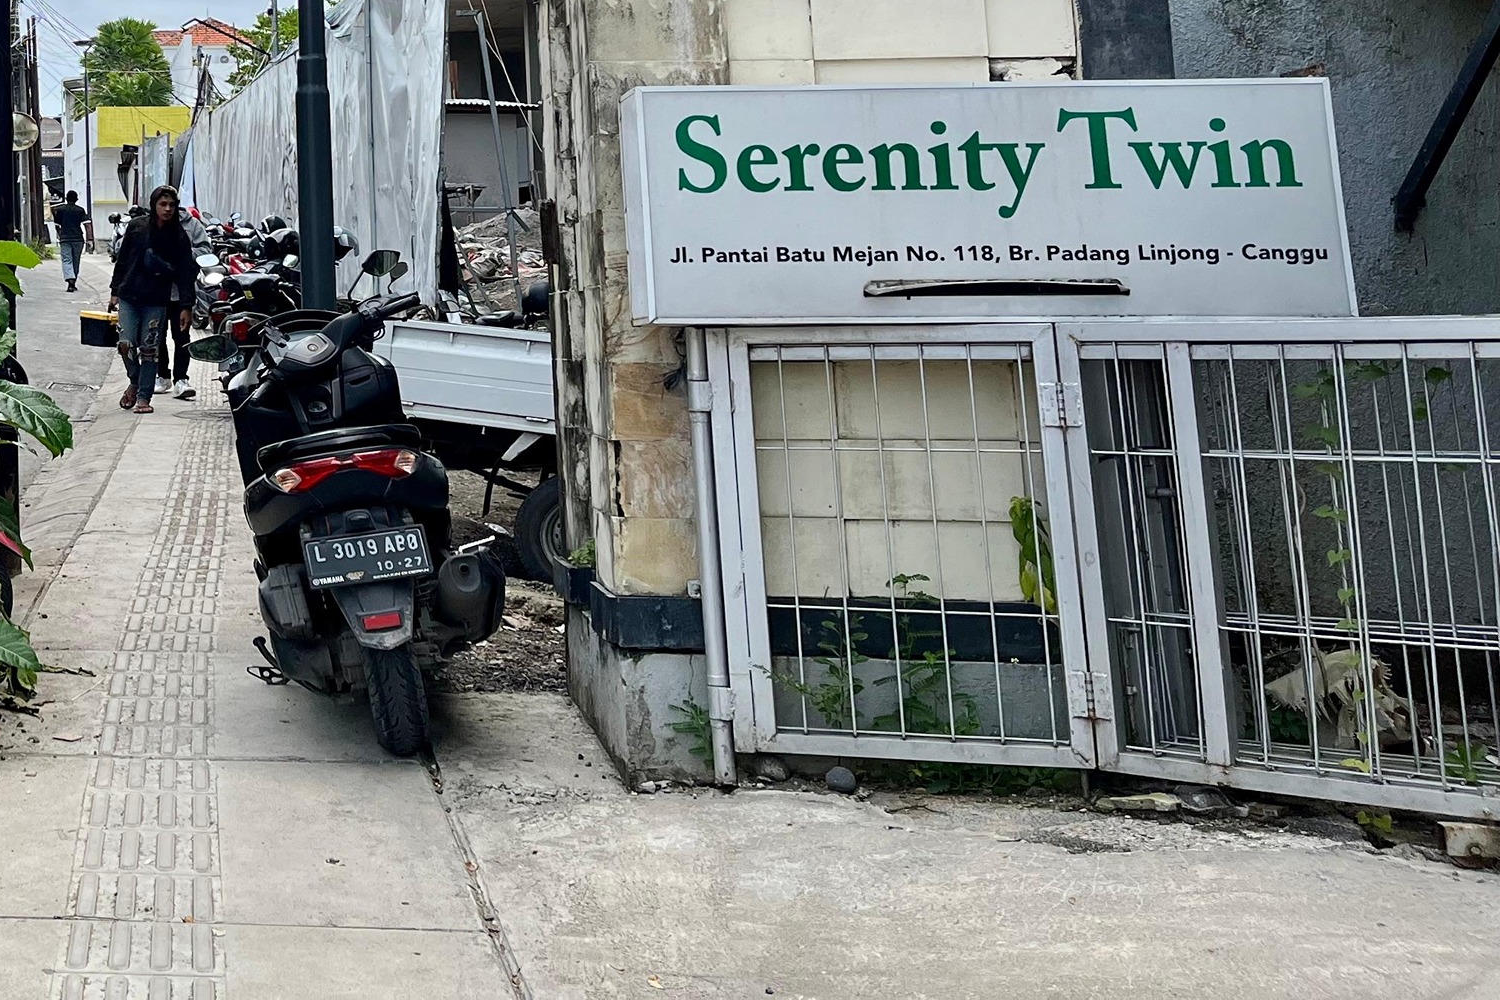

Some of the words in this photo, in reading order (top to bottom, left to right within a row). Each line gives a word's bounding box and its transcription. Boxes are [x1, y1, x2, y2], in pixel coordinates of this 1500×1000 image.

[674, 114, 1046, 219] Serenity
[1056, 107, 1304, 191] Twin
[670, 246, 694, 264] Jl.
[701, 246, 768, 263] Pantai
[776, 246, 825, 263] Batu
[832, 245, 899, 267] Mejan
[906, 245, 945, 262] No.
[953, 245, 1001, 264] 118,
[1009, 245, 1041, 261] Br.
[1046, 244, 1130, 266] Padang
[1138, 244, 1220, 265] Linjong
[1241, 243, 1329, 265] Canggu
[314, 545, 327, 562] L
[332, 539, 378, 559] 3019
